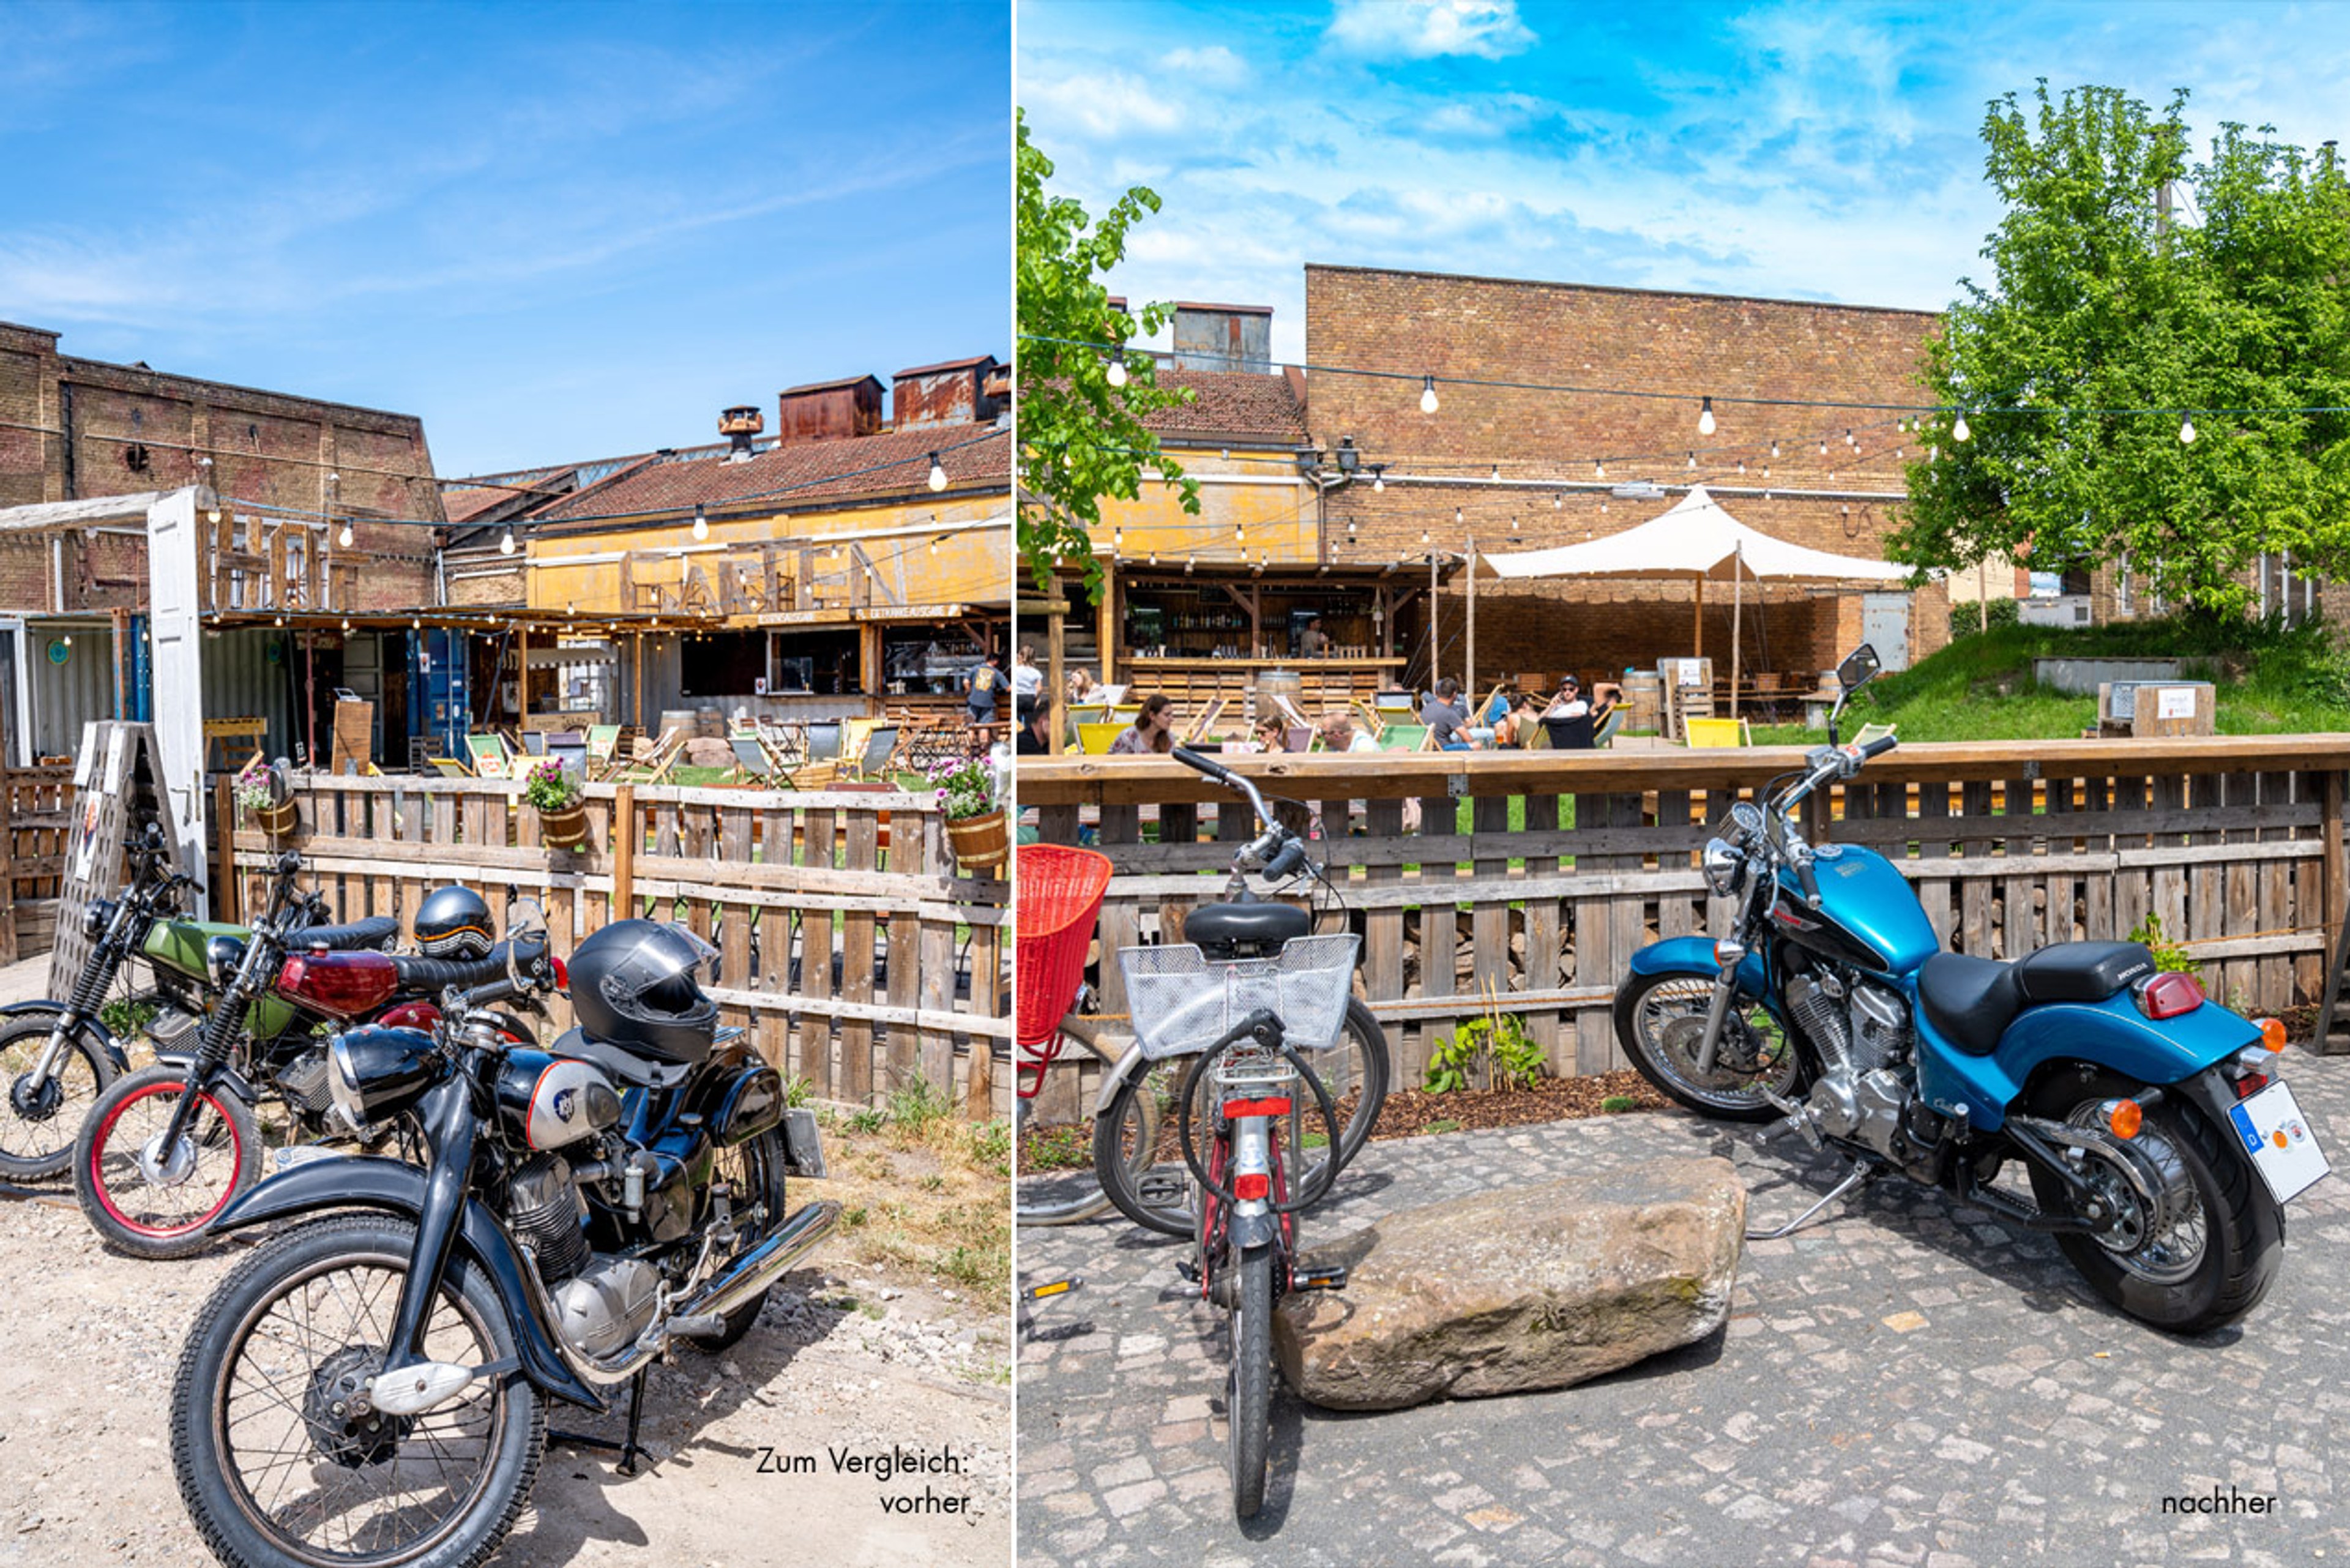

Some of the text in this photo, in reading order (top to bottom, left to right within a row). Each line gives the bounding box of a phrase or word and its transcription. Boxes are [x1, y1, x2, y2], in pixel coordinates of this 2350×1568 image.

[618, 537, 907, 614] GARTEN
[2117, 963, 2148, 980] HONDA
[2247, 1134, 2258, 1146] D
